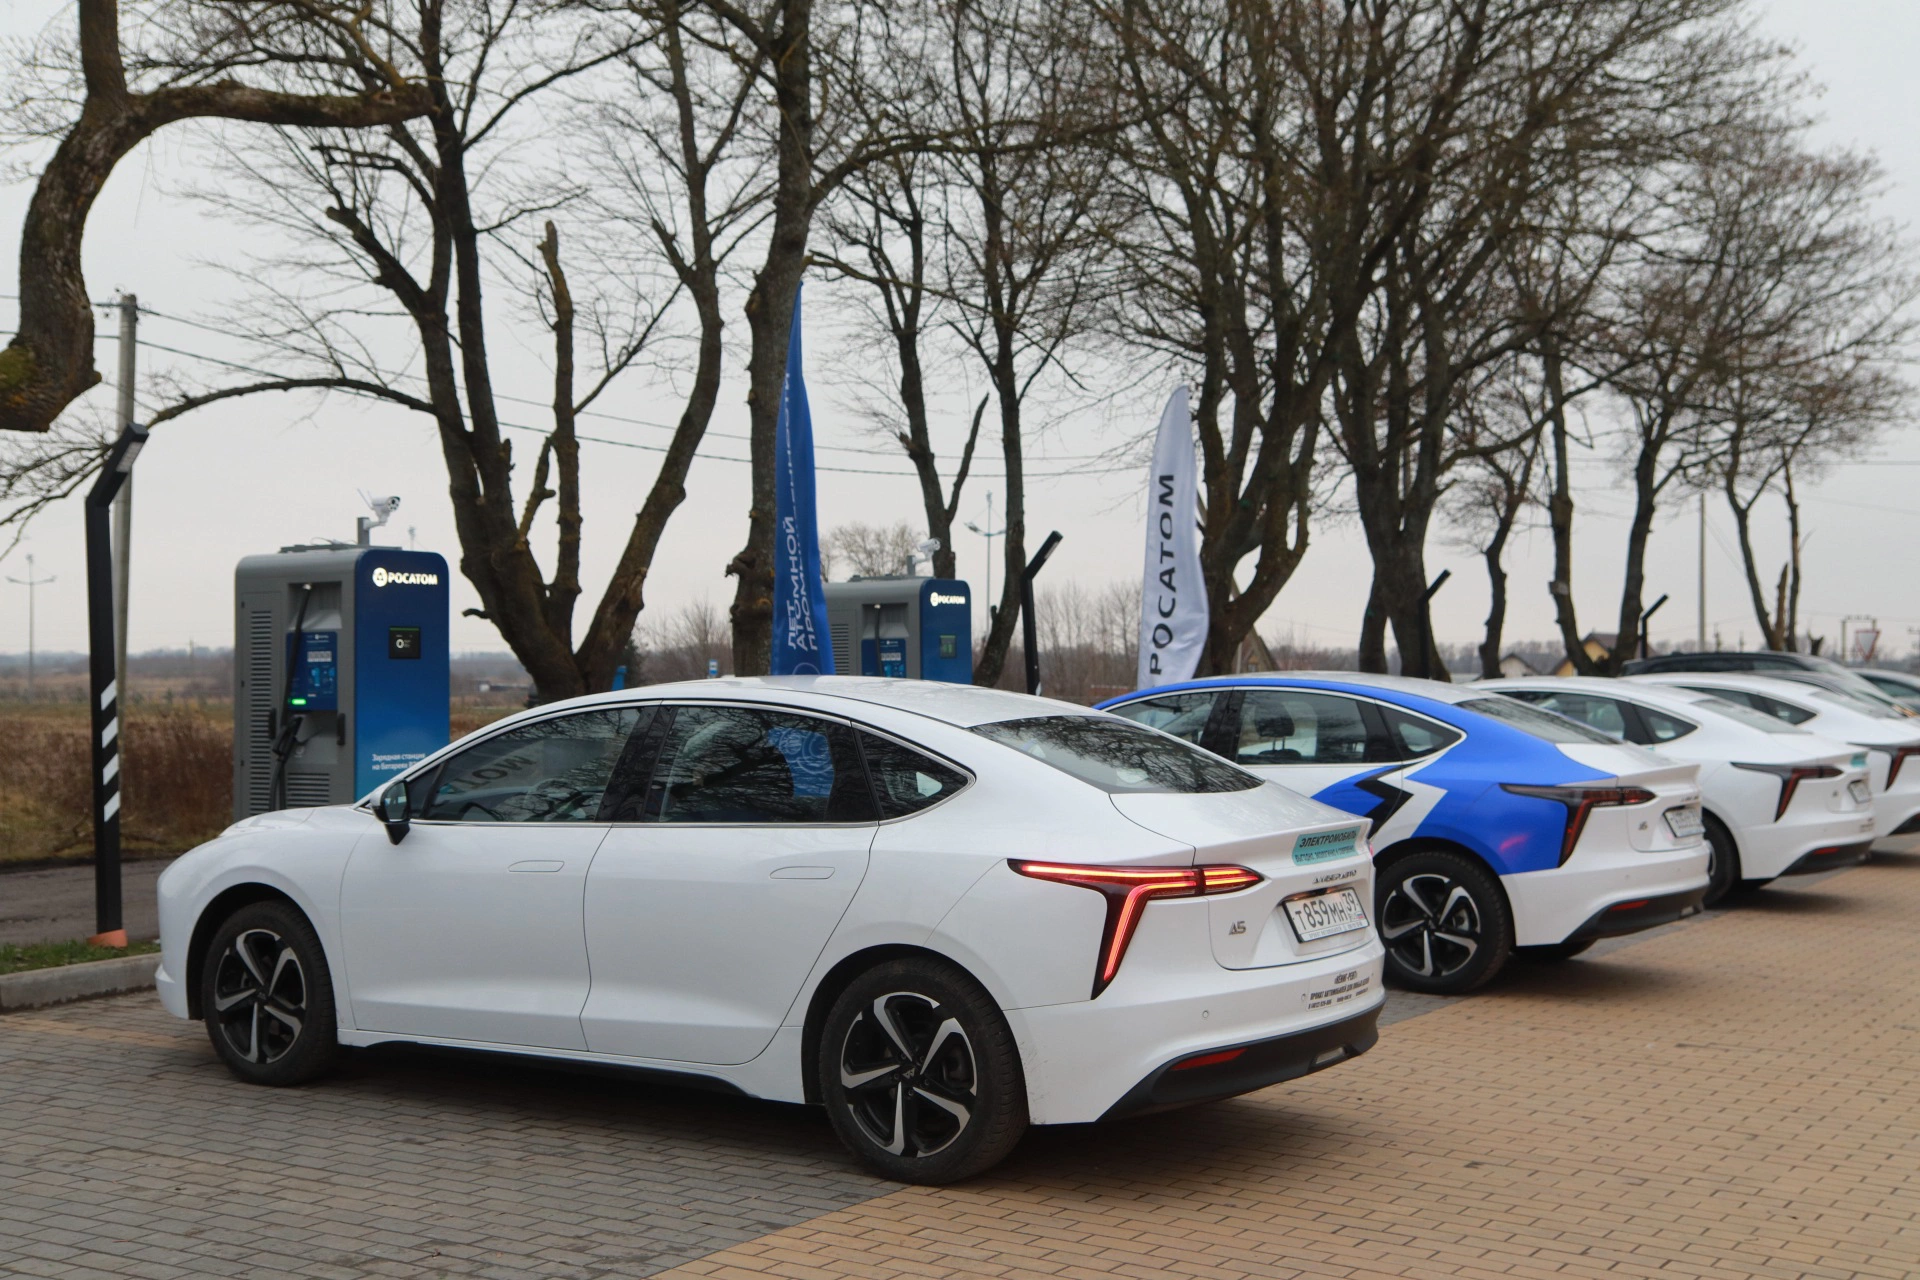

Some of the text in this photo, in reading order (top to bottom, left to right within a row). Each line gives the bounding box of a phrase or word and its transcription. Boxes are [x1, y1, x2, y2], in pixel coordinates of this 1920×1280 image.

[387, 572, 438, 585] РОСАТОМ
[782, 516, 808, 652] АТОМНОЙ
[1150, 474, 1176, 675] РОСАТОМ
[786, 600, 797, 649] ЛЕТ
[1299, 831, 1357, 848] ЭЛЕКТРОМОБИЛЬ
[1295, 892, 1357, 930] Т859МН 39
